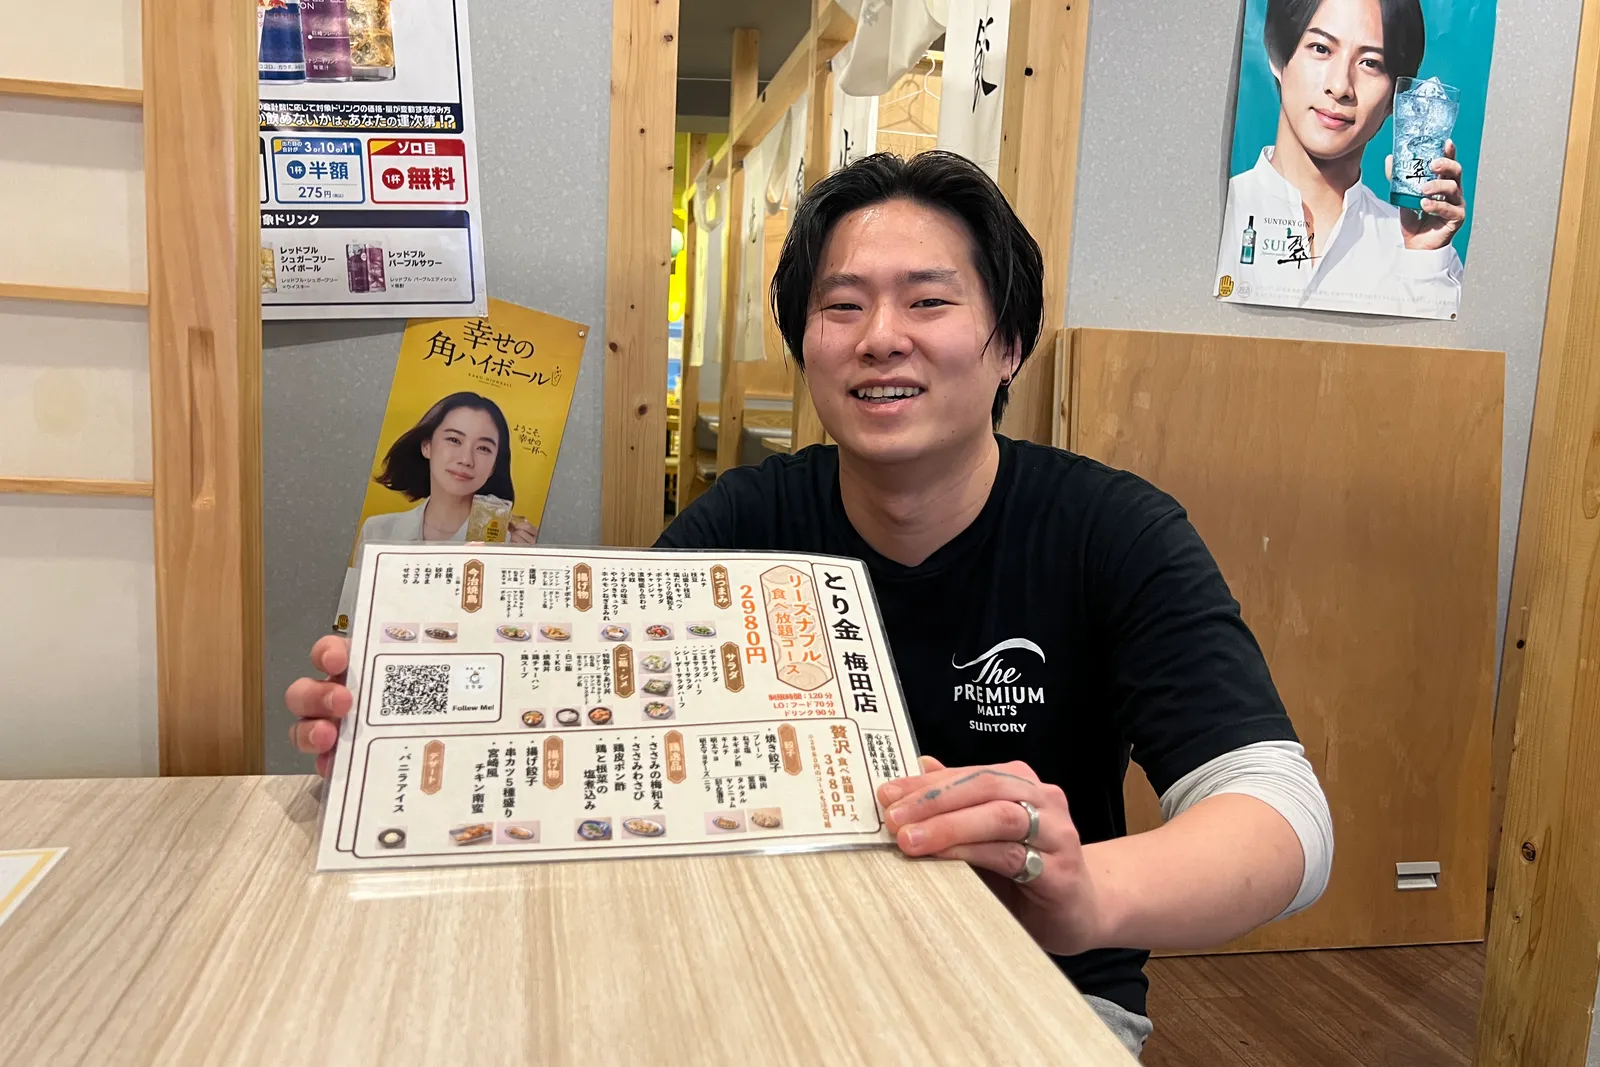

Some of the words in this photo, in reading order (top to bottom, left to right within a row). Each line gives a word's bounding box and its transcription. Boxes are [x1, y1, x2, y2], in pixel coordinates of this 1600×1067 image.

[290, 166, 303, 174] 1杯
[309, 161, 349, 180] 半額
[386, 174, 400, 184] 1杯
[407, 167, 455, 190] 無料
[261, 214, 319, 226] 象ドリンク
[1264, 217, 1296, 227] SUNTORY
[280, 246, 318, 255] レッドブル
[281, 255, 335, 263] シュガーフリー
[388, 250, 425, 259] レッドブル
[389, 259, 442, 267] パープルサワー
[1262, 238, 1287, 252] SUI
[281, 264, 321, 273] ハイボール
[422, 330, 551, 386] 角ハイボール
[463, 319, 535, 359] 幸せの
[520, 433, 542, 446] 幸せの
[466, 568, 479, 604] 今治焼鳥
[714, 571, 728, 604] おつまみ
[739, 584, 767, 664] 2980円
[788, 574, 822, 663] リーズナブル
[823, 571, 864, 641] とり金
[771, 587, 800, 675] 食べ放題コース
[726, 653, 740, 680] サラダ
[842, 651, 878, 713] 梅田店
[953, 683, 1045, 704] PREMIUM
[977, 704, 1018, 717] MALT'S
[765, 734, 781, 773] 焼き餃子
[830, 725, 852, 754] 贅沢
[393, 753, 412, 813] バニラアイス
[502, 748, 516, 818] 串カツ5種盛り
[525, 746, 538, 787] 揚げ餃子
[595, 743, 608, 794] 鶏と根菜の
[613, 743, 627, 792] 鶏皮ポン酢
[632, 742, 645, 801] ささみわさび
[649, 741, 663, 810] ささみの梅和え
[824, 754, 846, 817] 3480円
[583, 769, 596, 810] 塩煮込み
[838, 757, 859, 822] 食べ放題コース
